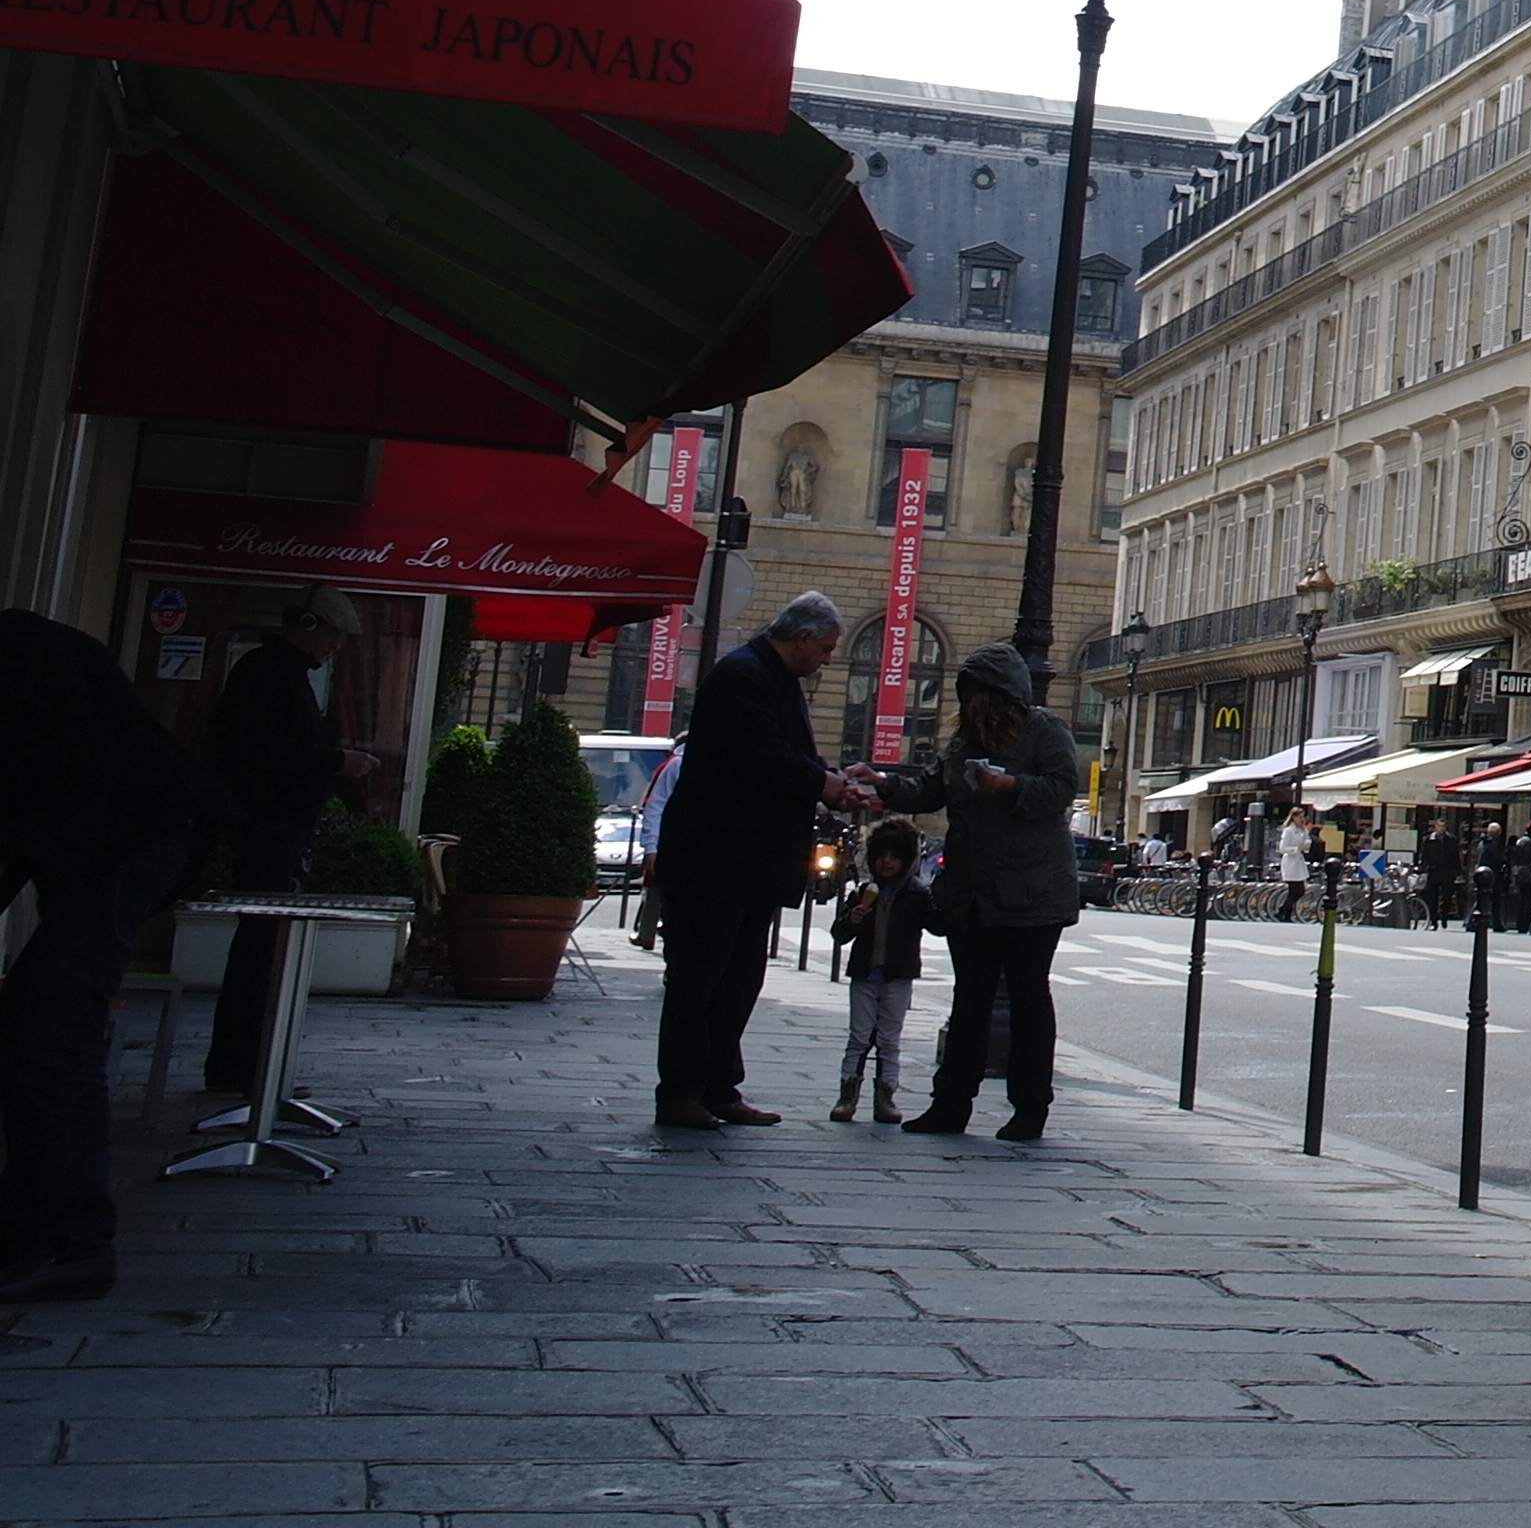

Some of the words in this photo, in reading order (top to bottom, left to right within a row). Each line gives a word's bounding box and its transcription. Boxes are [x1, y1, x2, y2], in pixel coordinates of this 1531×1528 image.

[422, 7, 694, 86] JAPONAIS
[671, 448, 692, 488] Loup
[669, 493, 684, 514] du
[901, 479, 922, 528] 1932
[217, 522, 396, 565] Restaurant
[404, 536, 454, 570] Le
[458, 541, 632, 589] Montegrosso
[894, 536, 916, 597] depuis
[897, 603, 908, 620] SA
[664, 638, 678, 680] boutique
[884, 626, 906, 687] Ricard
